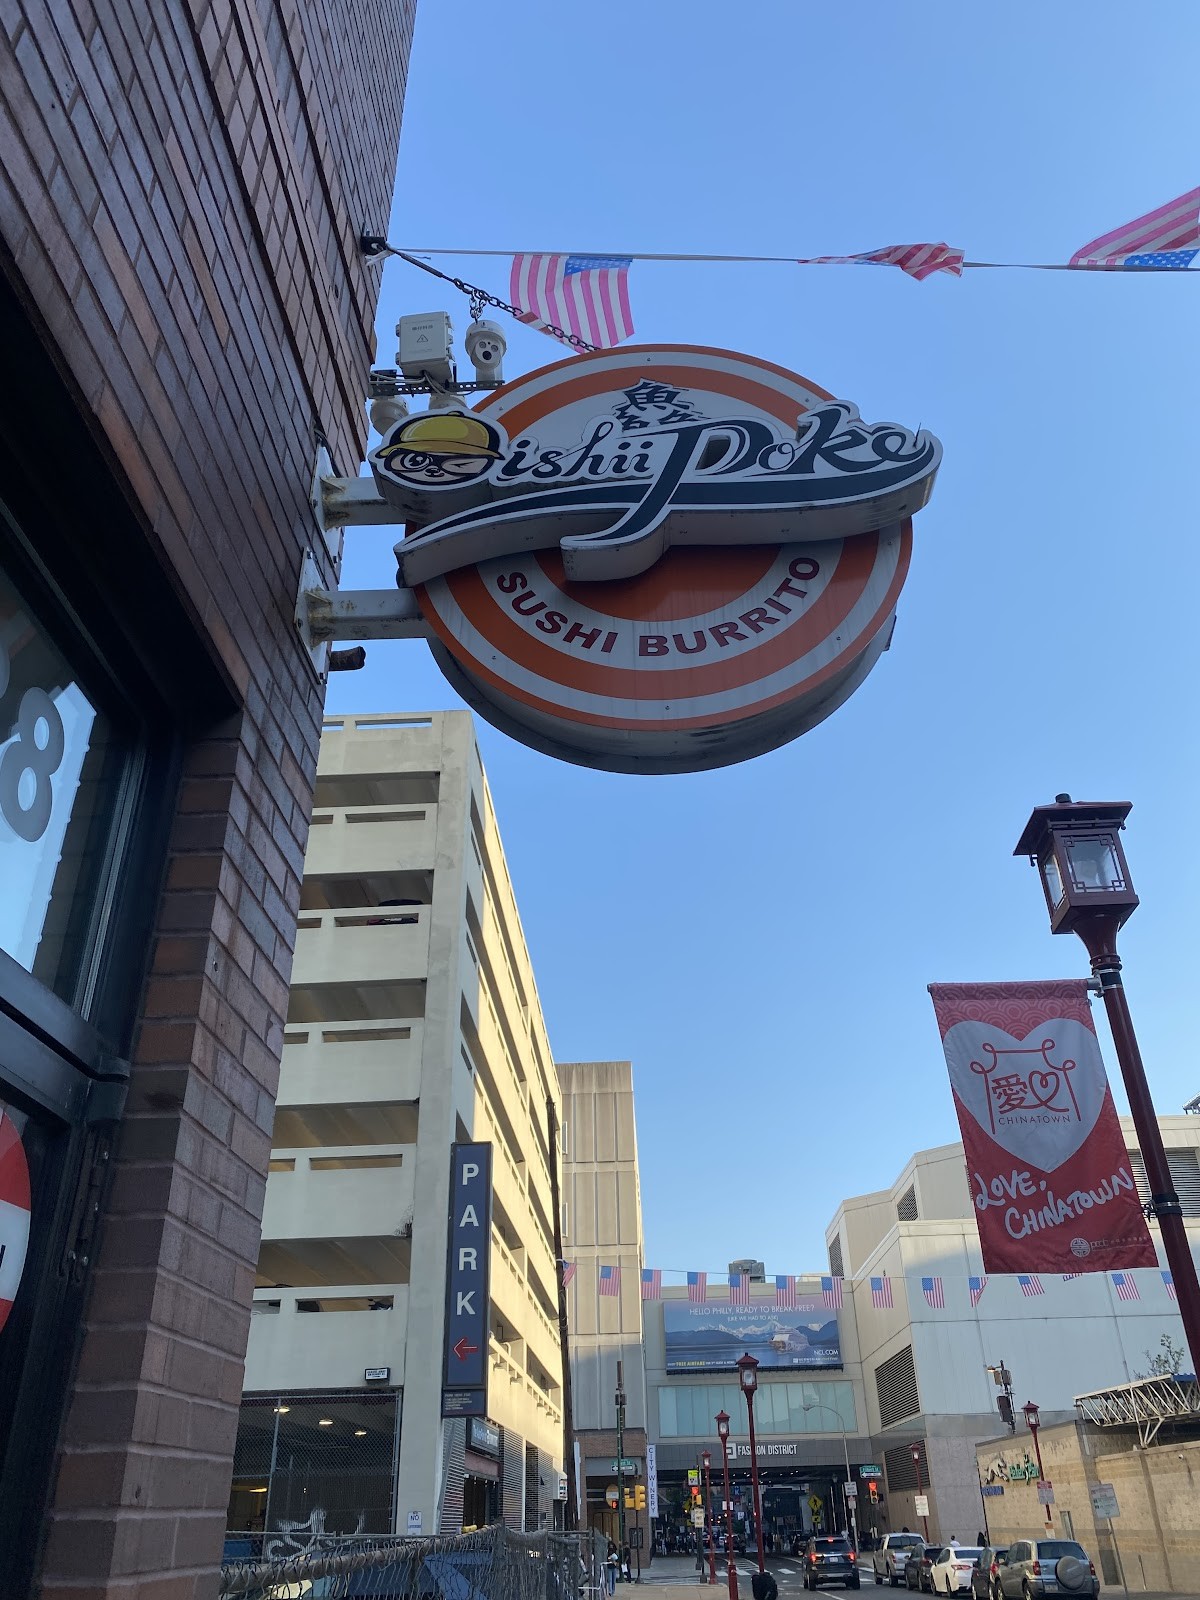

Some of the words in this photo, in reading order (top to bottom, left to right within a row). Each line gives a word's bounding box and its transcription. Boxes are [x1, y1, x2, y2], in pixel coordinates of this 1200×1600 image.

[496, 571, 617, 654] SUSHI
[637, 556, 820, 657] BURRITO
[991, 1073, 1028, 1115] 愛
[998, 1115, 1071, 1126] CHINATOWN
[974, 1169, 1047, 1210] LOVE,
[1004, 1167, 1134, 1239] CHINATOWN
[456, 1163, 480, 1316] PARK
[689, 1307, 711, 1316] HELLO
[712, 1307, 735, 1316] PHILLY,
[736, 1306, 758, 1314] READY
[759, 1305, 770, 1313] TO
[771, 1305, 793, 1313] BREAK
[795, 1304, 815, 1312] FREE?
[737, 1445, 766, 1456] FASON
[767, 1444, 798, 1455] DISTRICT
[648, 1474, 656, 1514] WINERY
